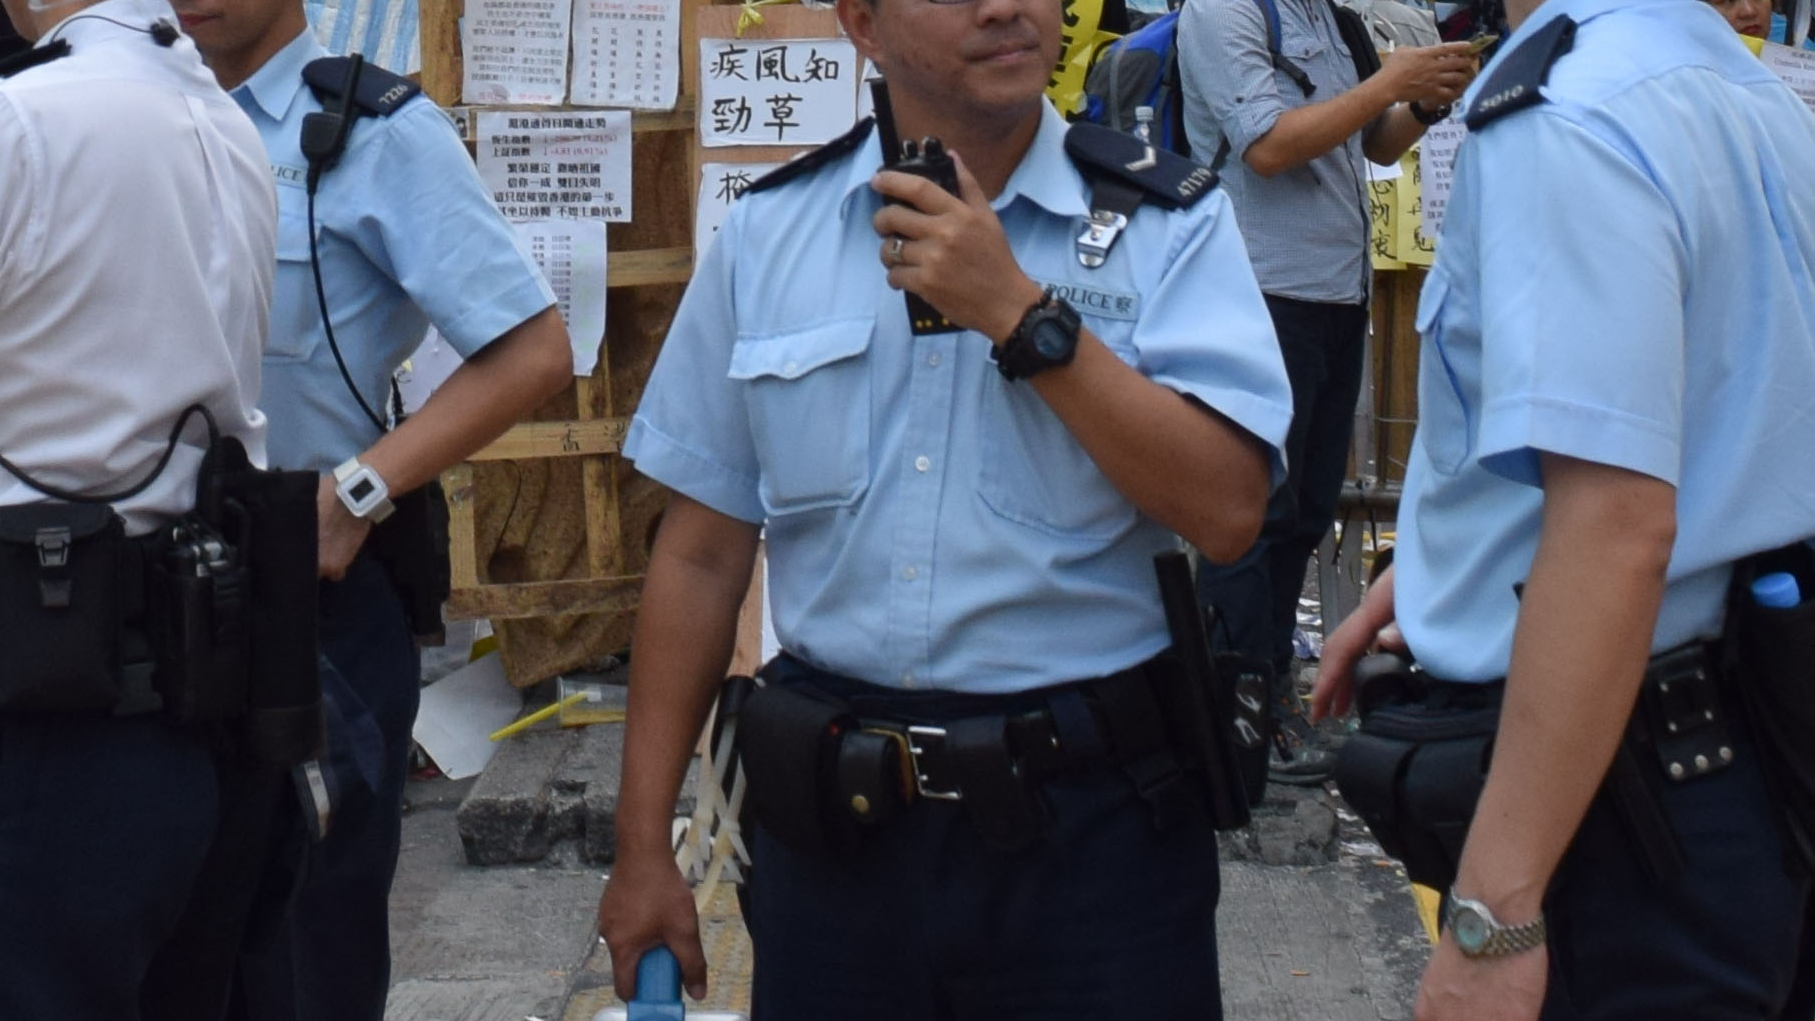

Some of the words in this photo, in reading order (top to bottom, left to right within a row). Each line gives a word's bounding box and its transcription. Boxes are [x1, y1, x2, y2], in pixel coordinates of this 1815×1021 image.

[709, 43, 839, 83] 疾風知
[711, 92, 804, 142] 勁草
[1047, 282, 1113, 311] POLICE
